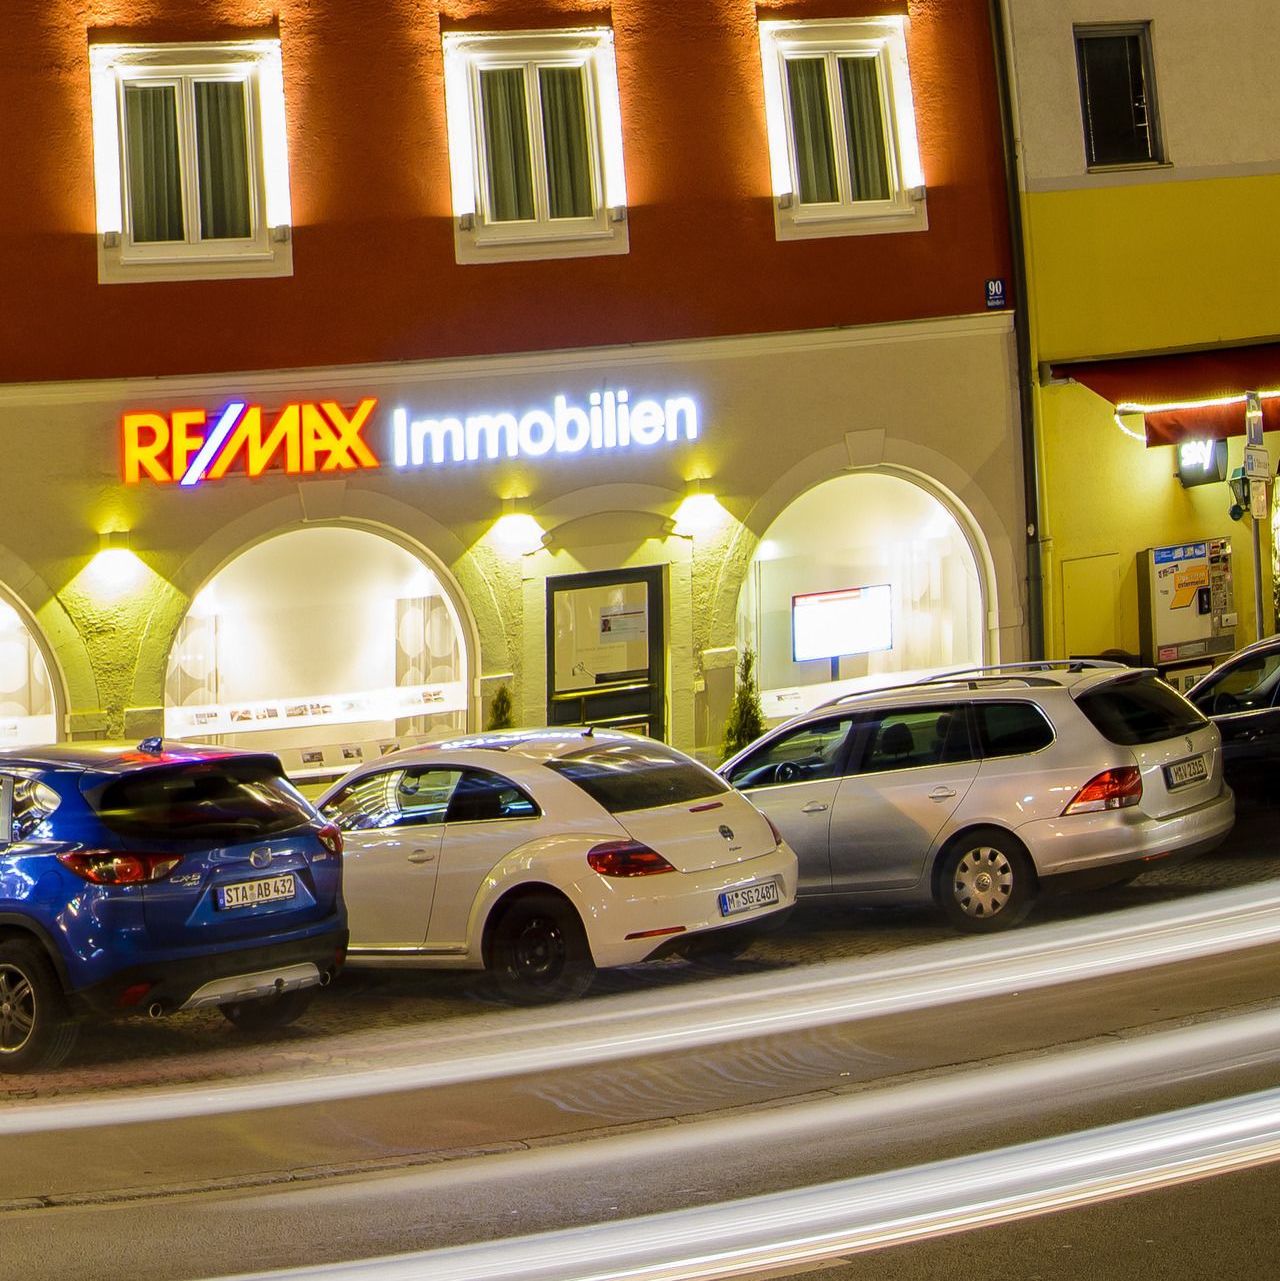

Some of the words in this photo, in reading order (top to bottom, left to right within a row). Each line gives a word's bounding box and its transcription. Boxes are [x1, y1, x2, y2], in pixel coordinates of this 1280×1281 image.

[989, 280, 1002, 295] 90
[122, 397, 381, 487] RE/MAX
[393, 389, 698, 467] Immobilien
[225, 886, 249, 904] STA
[257, 882, 271, 899] AB
[273, 878, 294, 897] 432
[727, 895, 736, 910] M
[741, 889, 754, 906] SG
[754, 884, 776, 903] 2487
